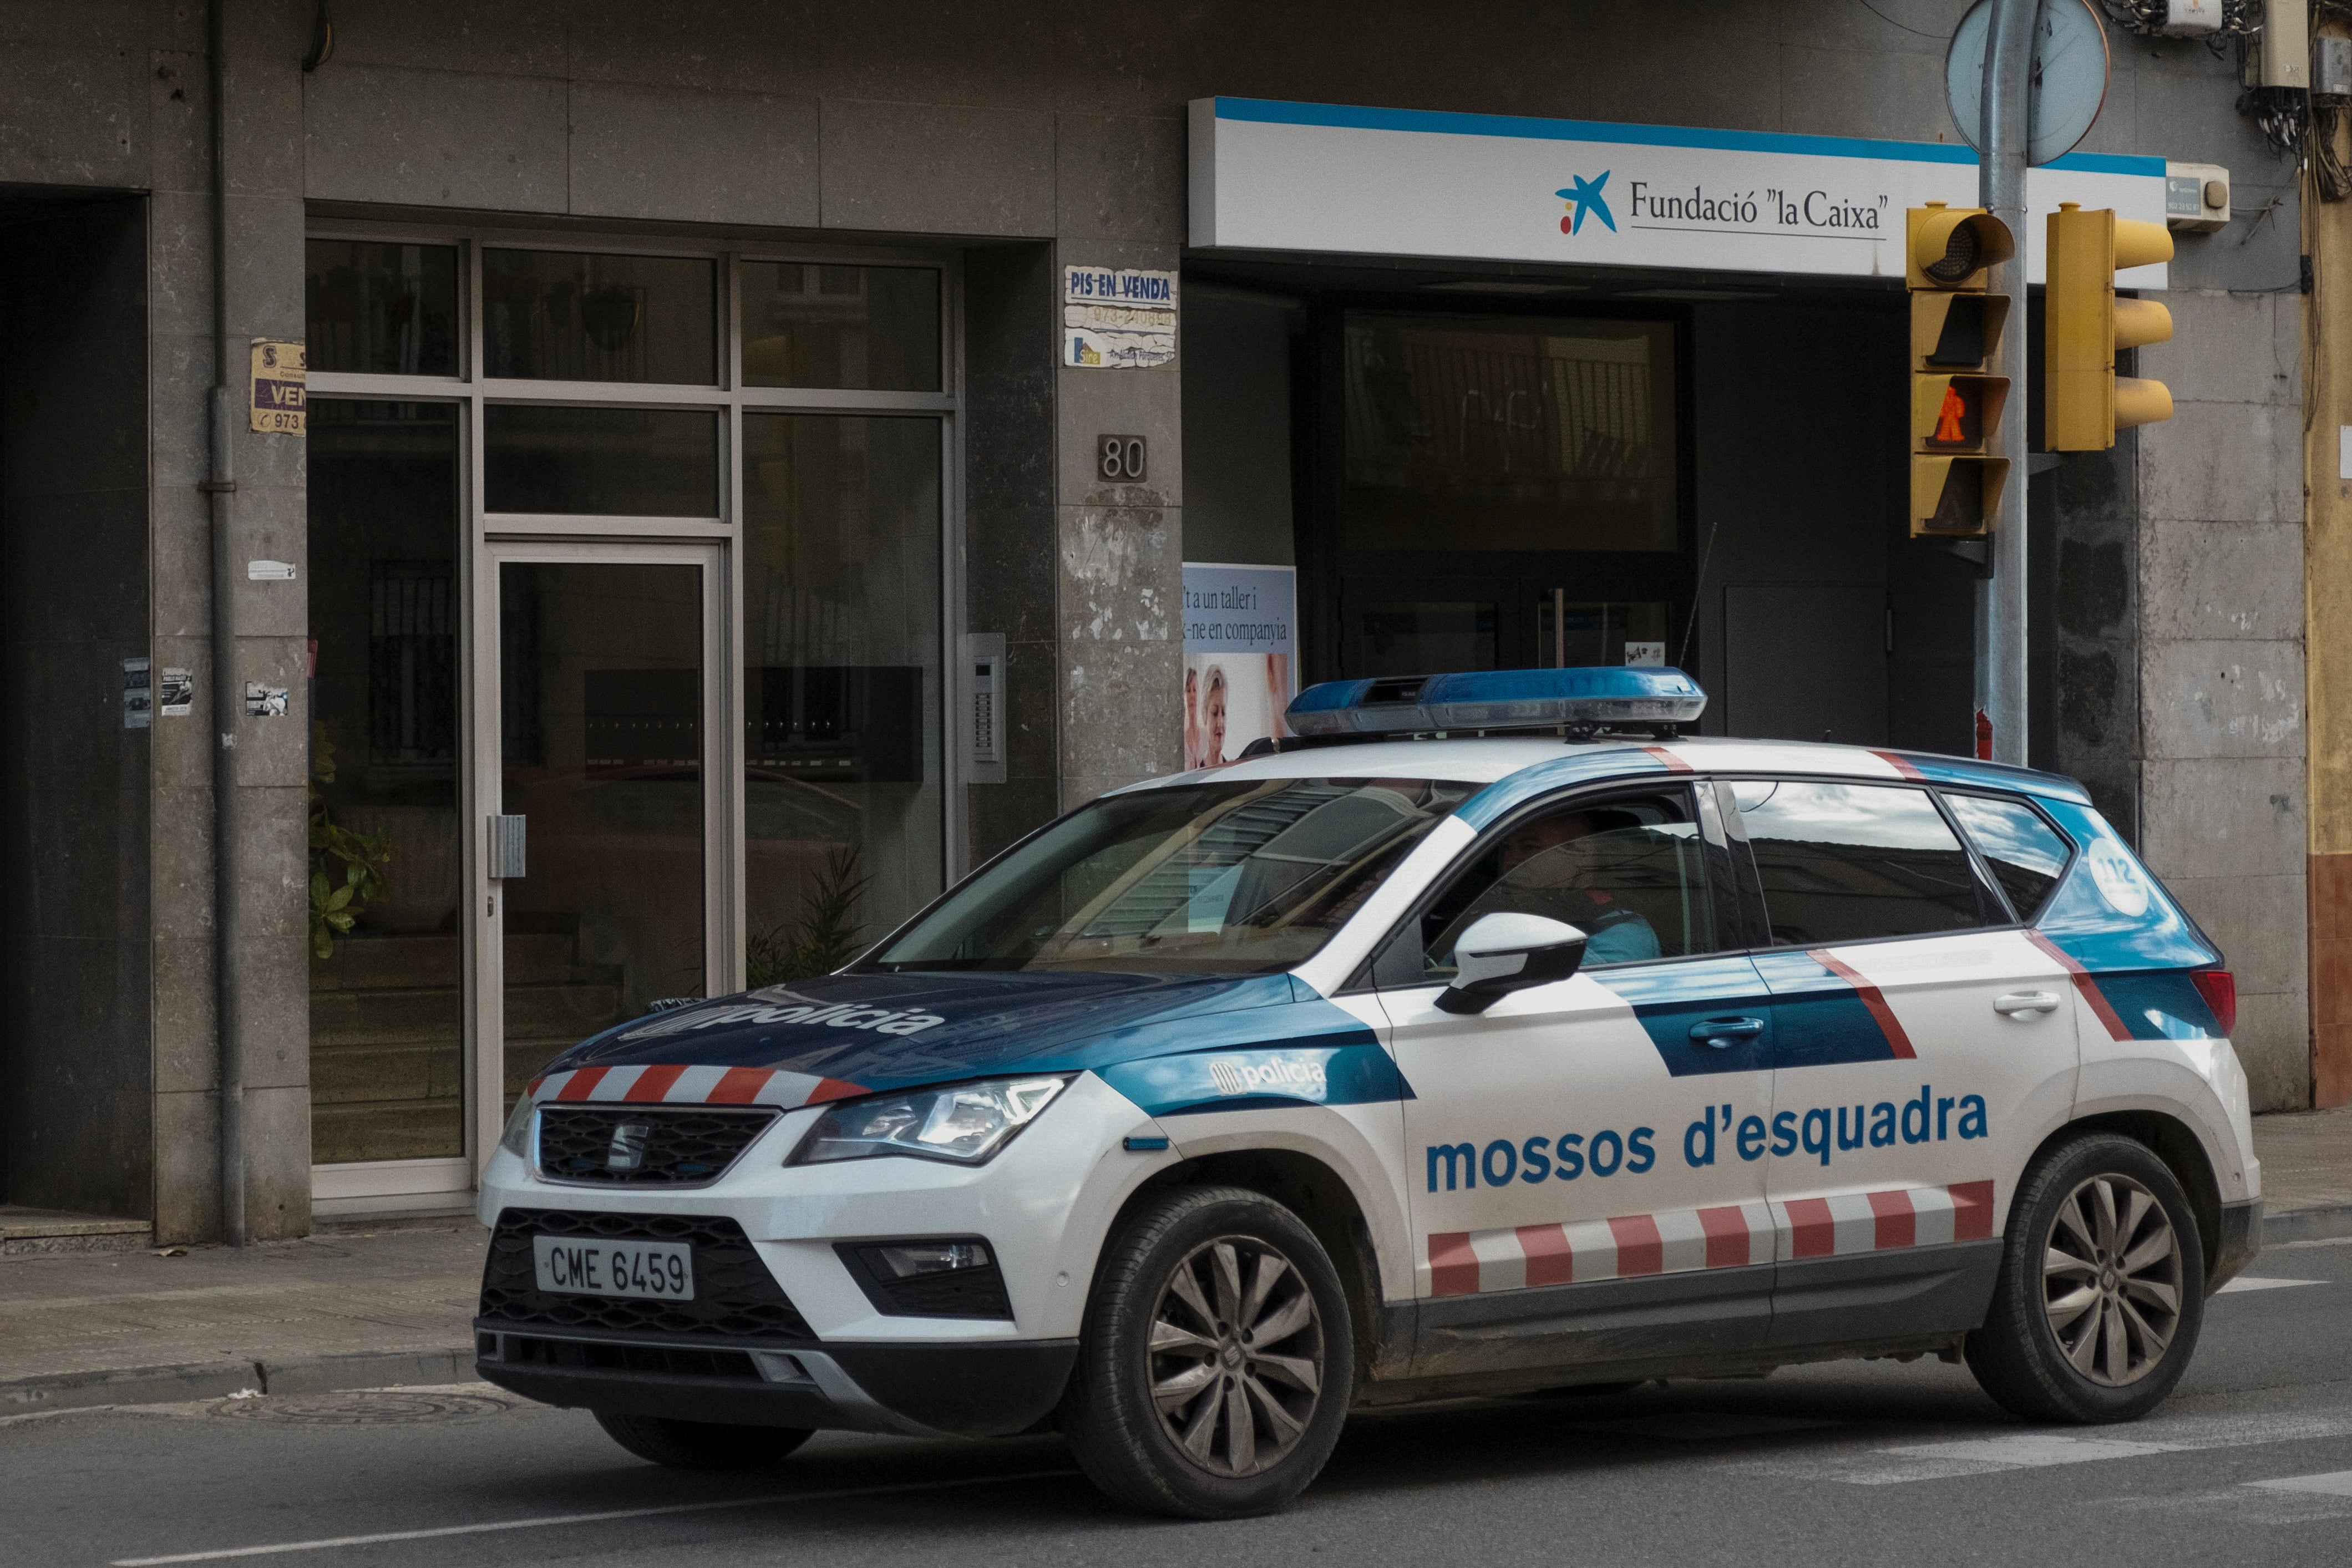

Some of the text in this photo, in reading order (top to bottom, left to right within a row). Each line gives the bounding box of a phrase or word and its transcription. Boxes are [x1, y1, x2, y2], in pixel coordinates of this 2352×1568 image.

[1631, 181, 1757, 224] Fundació
[1071, 272, 1170, 301] PIS EN VENDA
[263, 346, 277, 368] S
[275, 414, 298, 429] 973
[1103, 438, 1144, 478] 80
[1193, 592, 1200, 608] a
[1204, 592, 1218, 609] un
[1221, 586, 1250, 610] taller
[1253, 586, 1256, 610] i
[1209, 622, 1222, 639] en
[1225, 617, 1286, 646] companyia
[2097, 856, 2137, 884] 112
[693, 1002, 945, 1036] policia
[1240, 1056, 1327, 1092] policia
[1426, 1084, 1988, 1193] mossos d'esquadra
[550, 1247, 685, 1295] CME 6459
